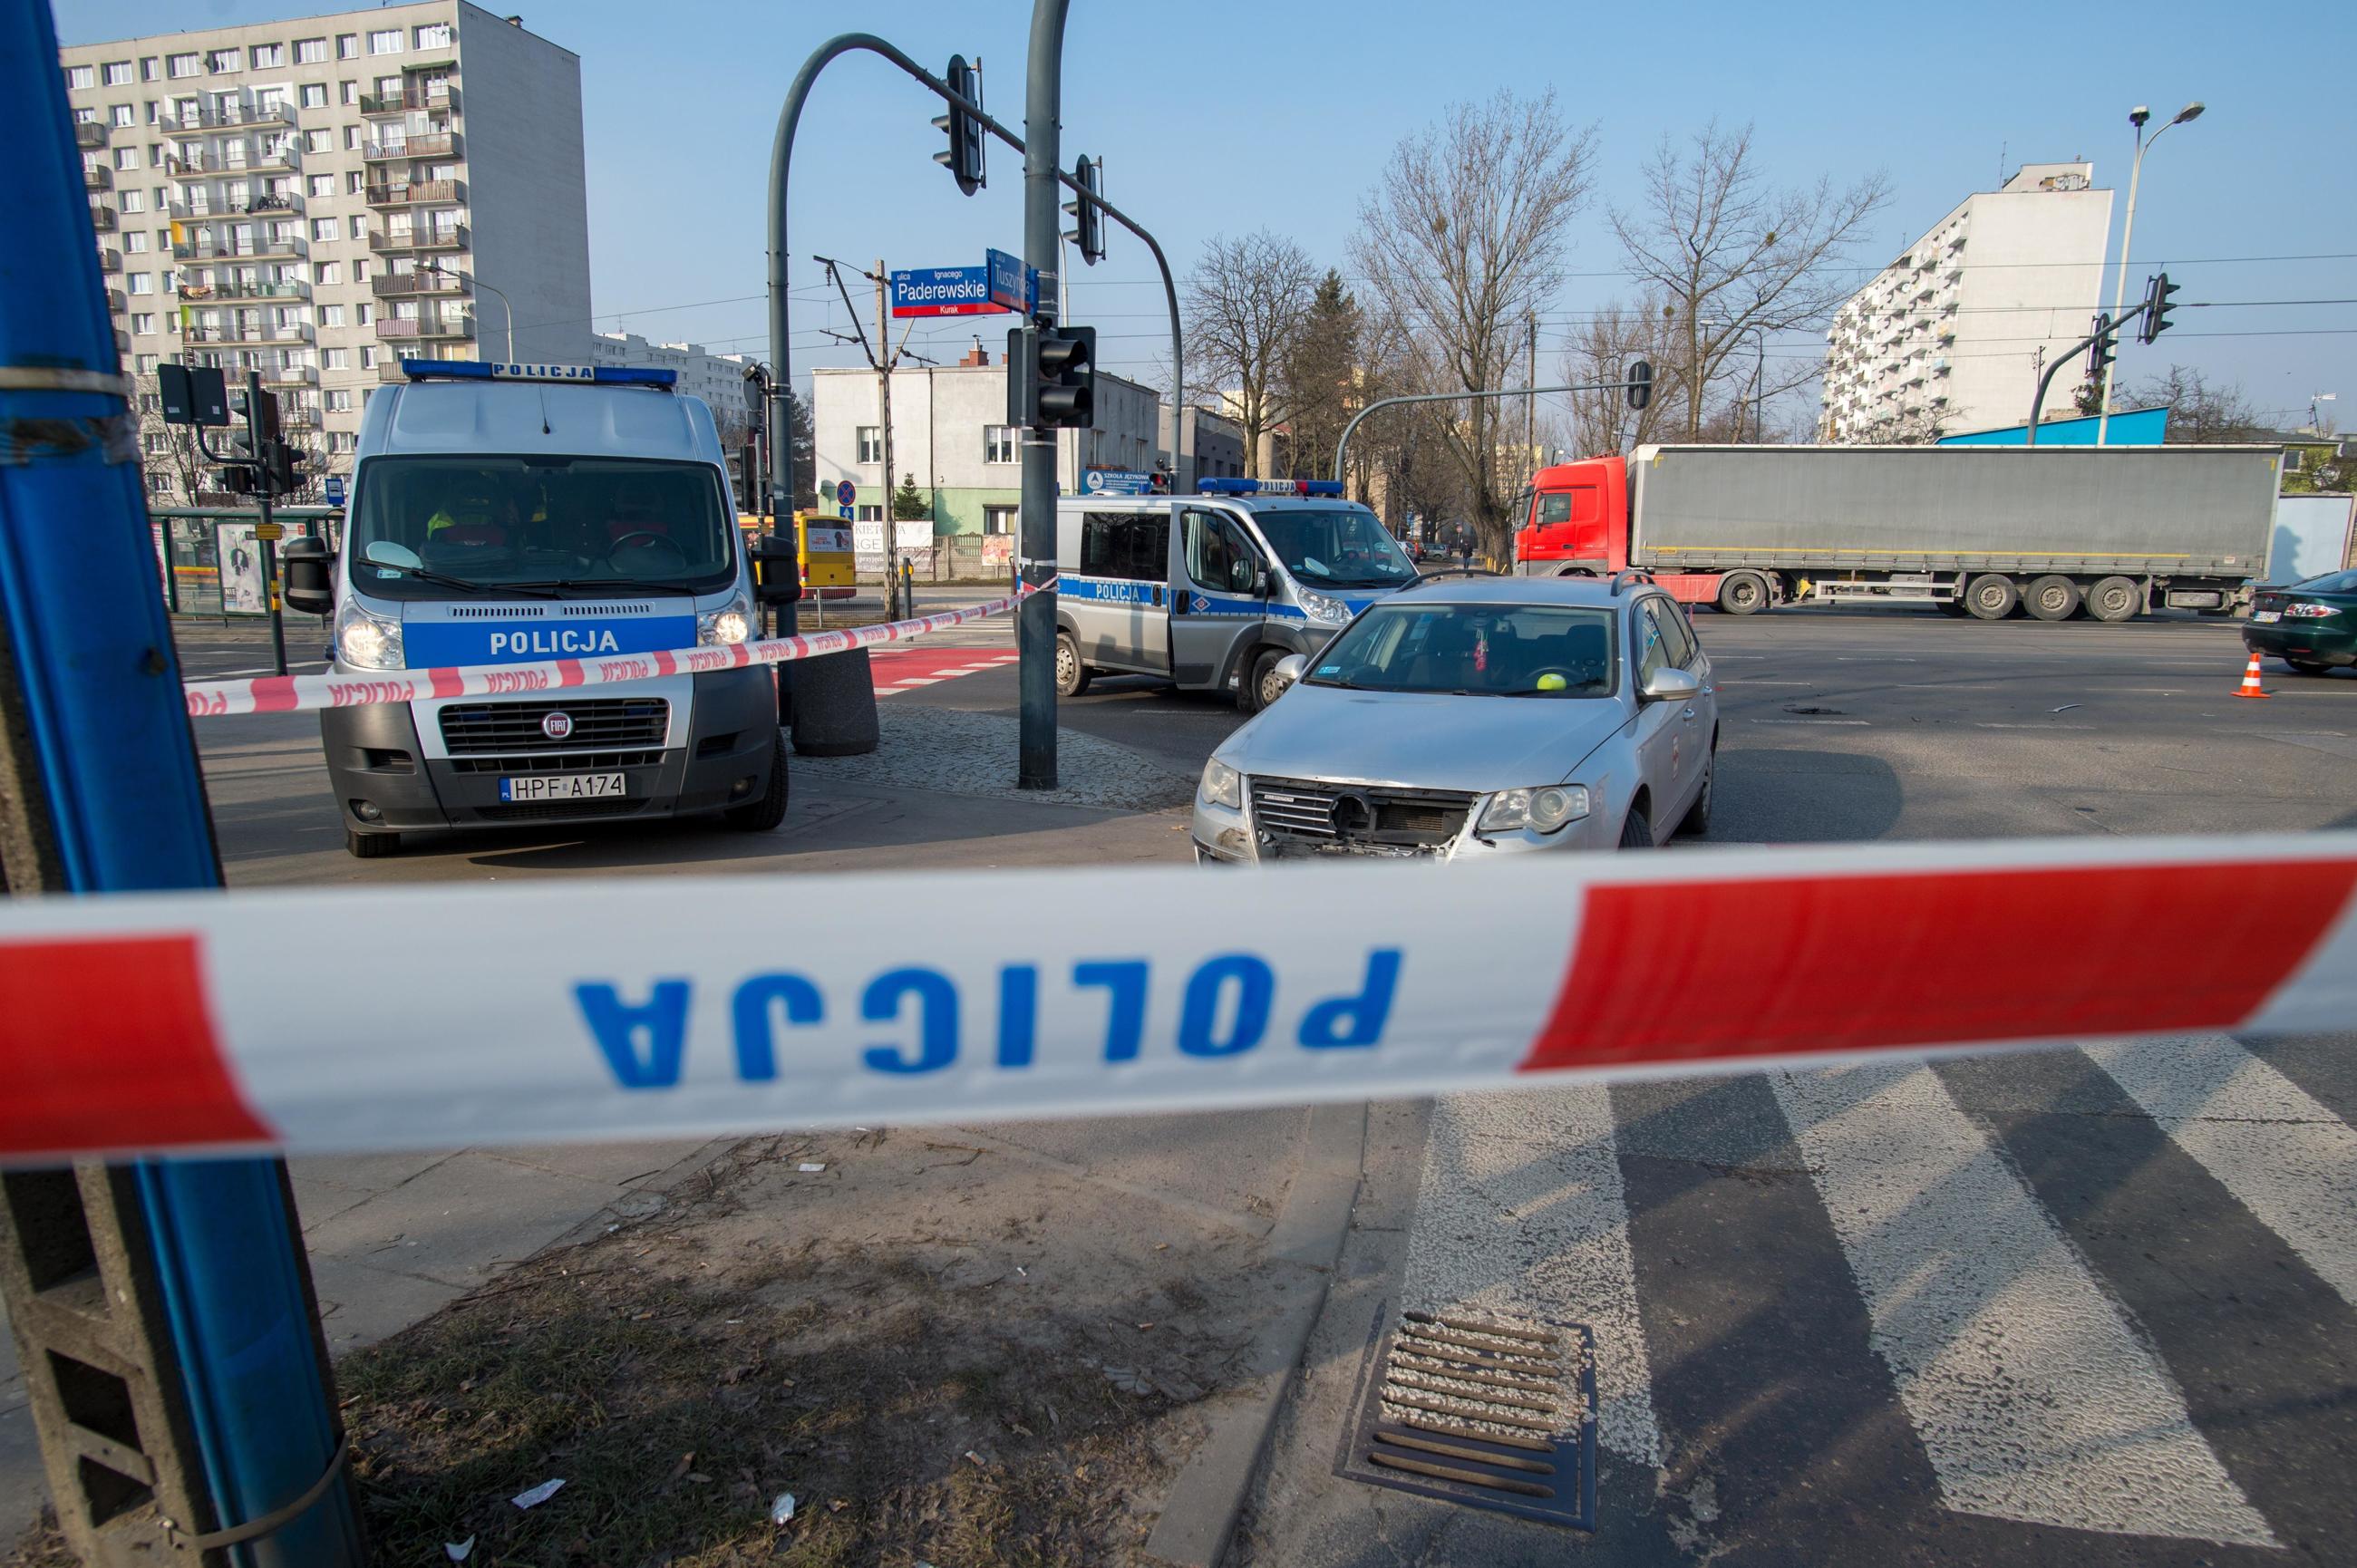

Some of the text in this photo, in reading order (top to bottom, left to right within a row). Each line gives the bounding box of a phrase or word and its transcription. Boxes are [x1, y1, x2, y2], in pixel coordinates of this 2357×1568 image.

[897, 273, 911, 281] ulica
[935, 270, 963, 281] Ignacego
[898, 280, 985, 301] Paderewskie
[940, 305, 958, 314] Kurak
[493, 363, 593, 378] POLICJA
[1257, 480, 1295, 491] POLICJA
[1096, 584, 1140, 602] POLICJA
[490, 630, 619, 654] POLICJA
[815, 634, 842, 651] POLICJA
[862, 625, 886, 642] POLICJA
[758, 642, 791, 661] POLICJA
[687, 651, 727, 671] POLICJA
[599, 660, 648, 682] POLICJA
[484, 669, 548, 694] POLICJA
[327, 680, 415, 707] POLICJA
[549, 720, 567, 731] FIAT
[515, 775, 622, 799] HPF A174
[573, 948, 1402, 1088] POLICJA
